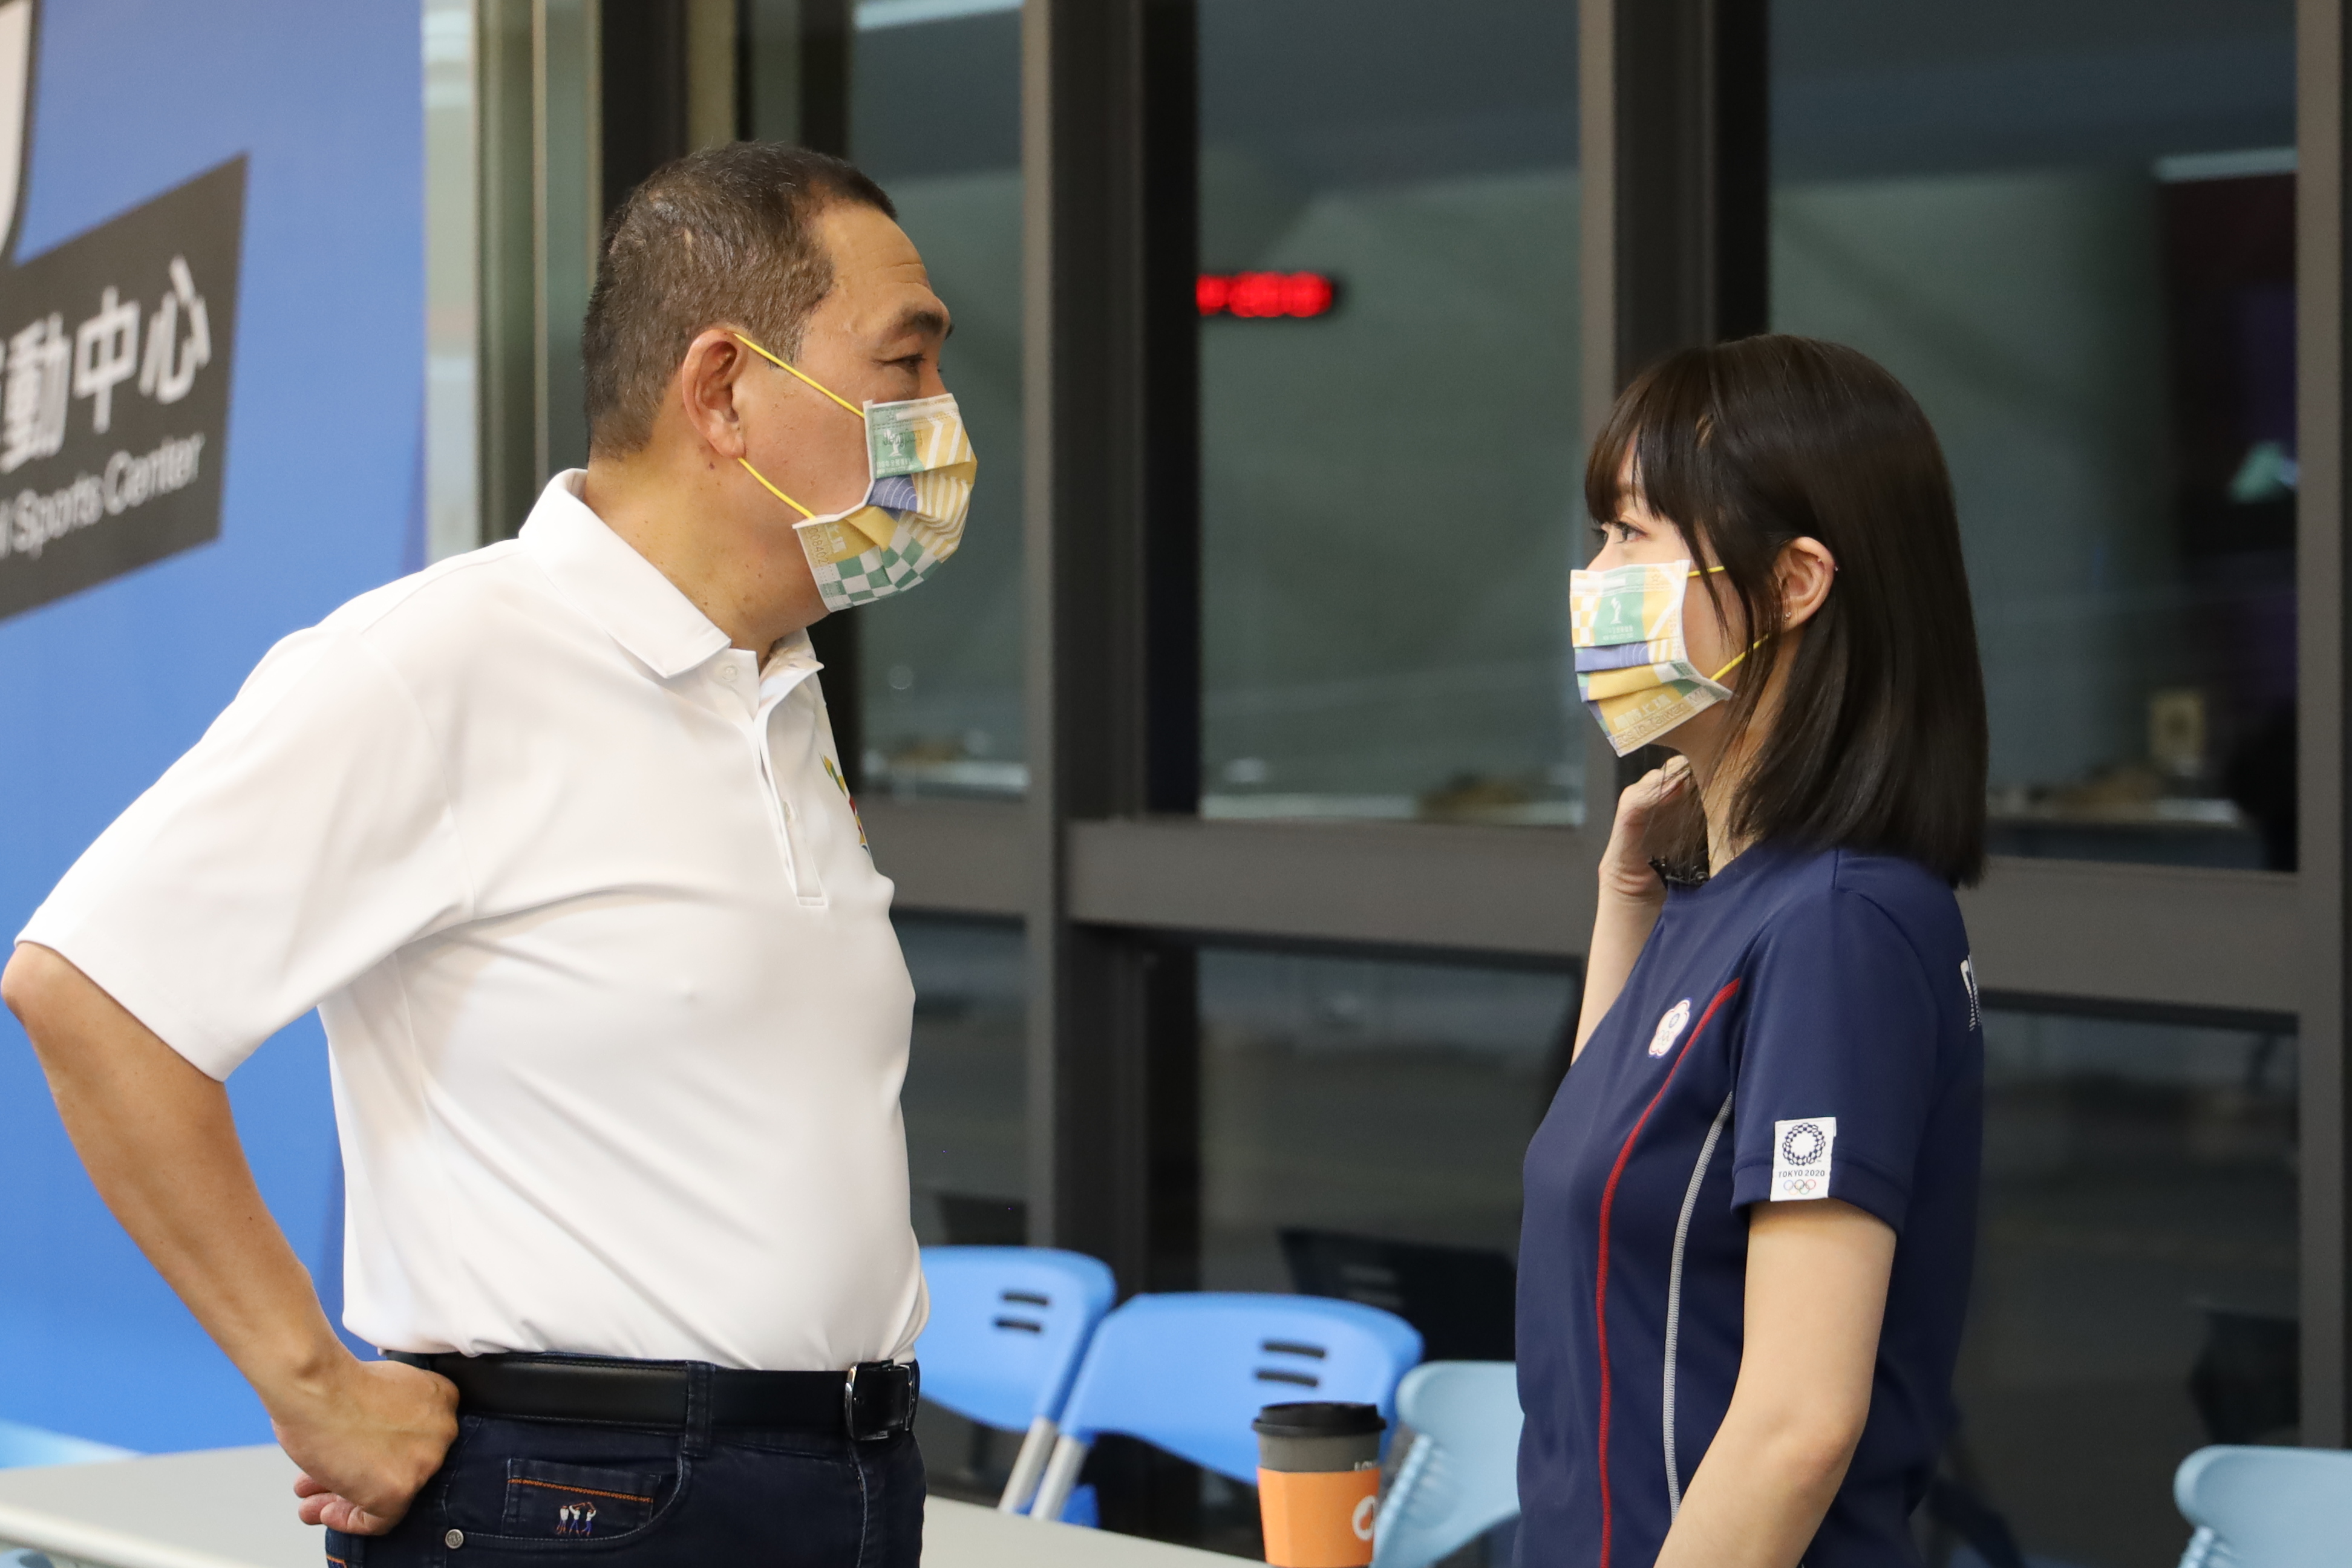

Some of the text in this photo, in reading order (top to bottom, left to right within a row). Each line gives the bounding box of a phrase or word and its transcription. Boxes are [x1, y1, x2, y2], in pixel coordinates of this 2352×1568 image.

[0, 254, 211, 473] 動中心
[12, 470, 103, 559] Sports
[103, 433, 206, 514] Center
[1779, 1169, 1803, 1178] TOKYO
